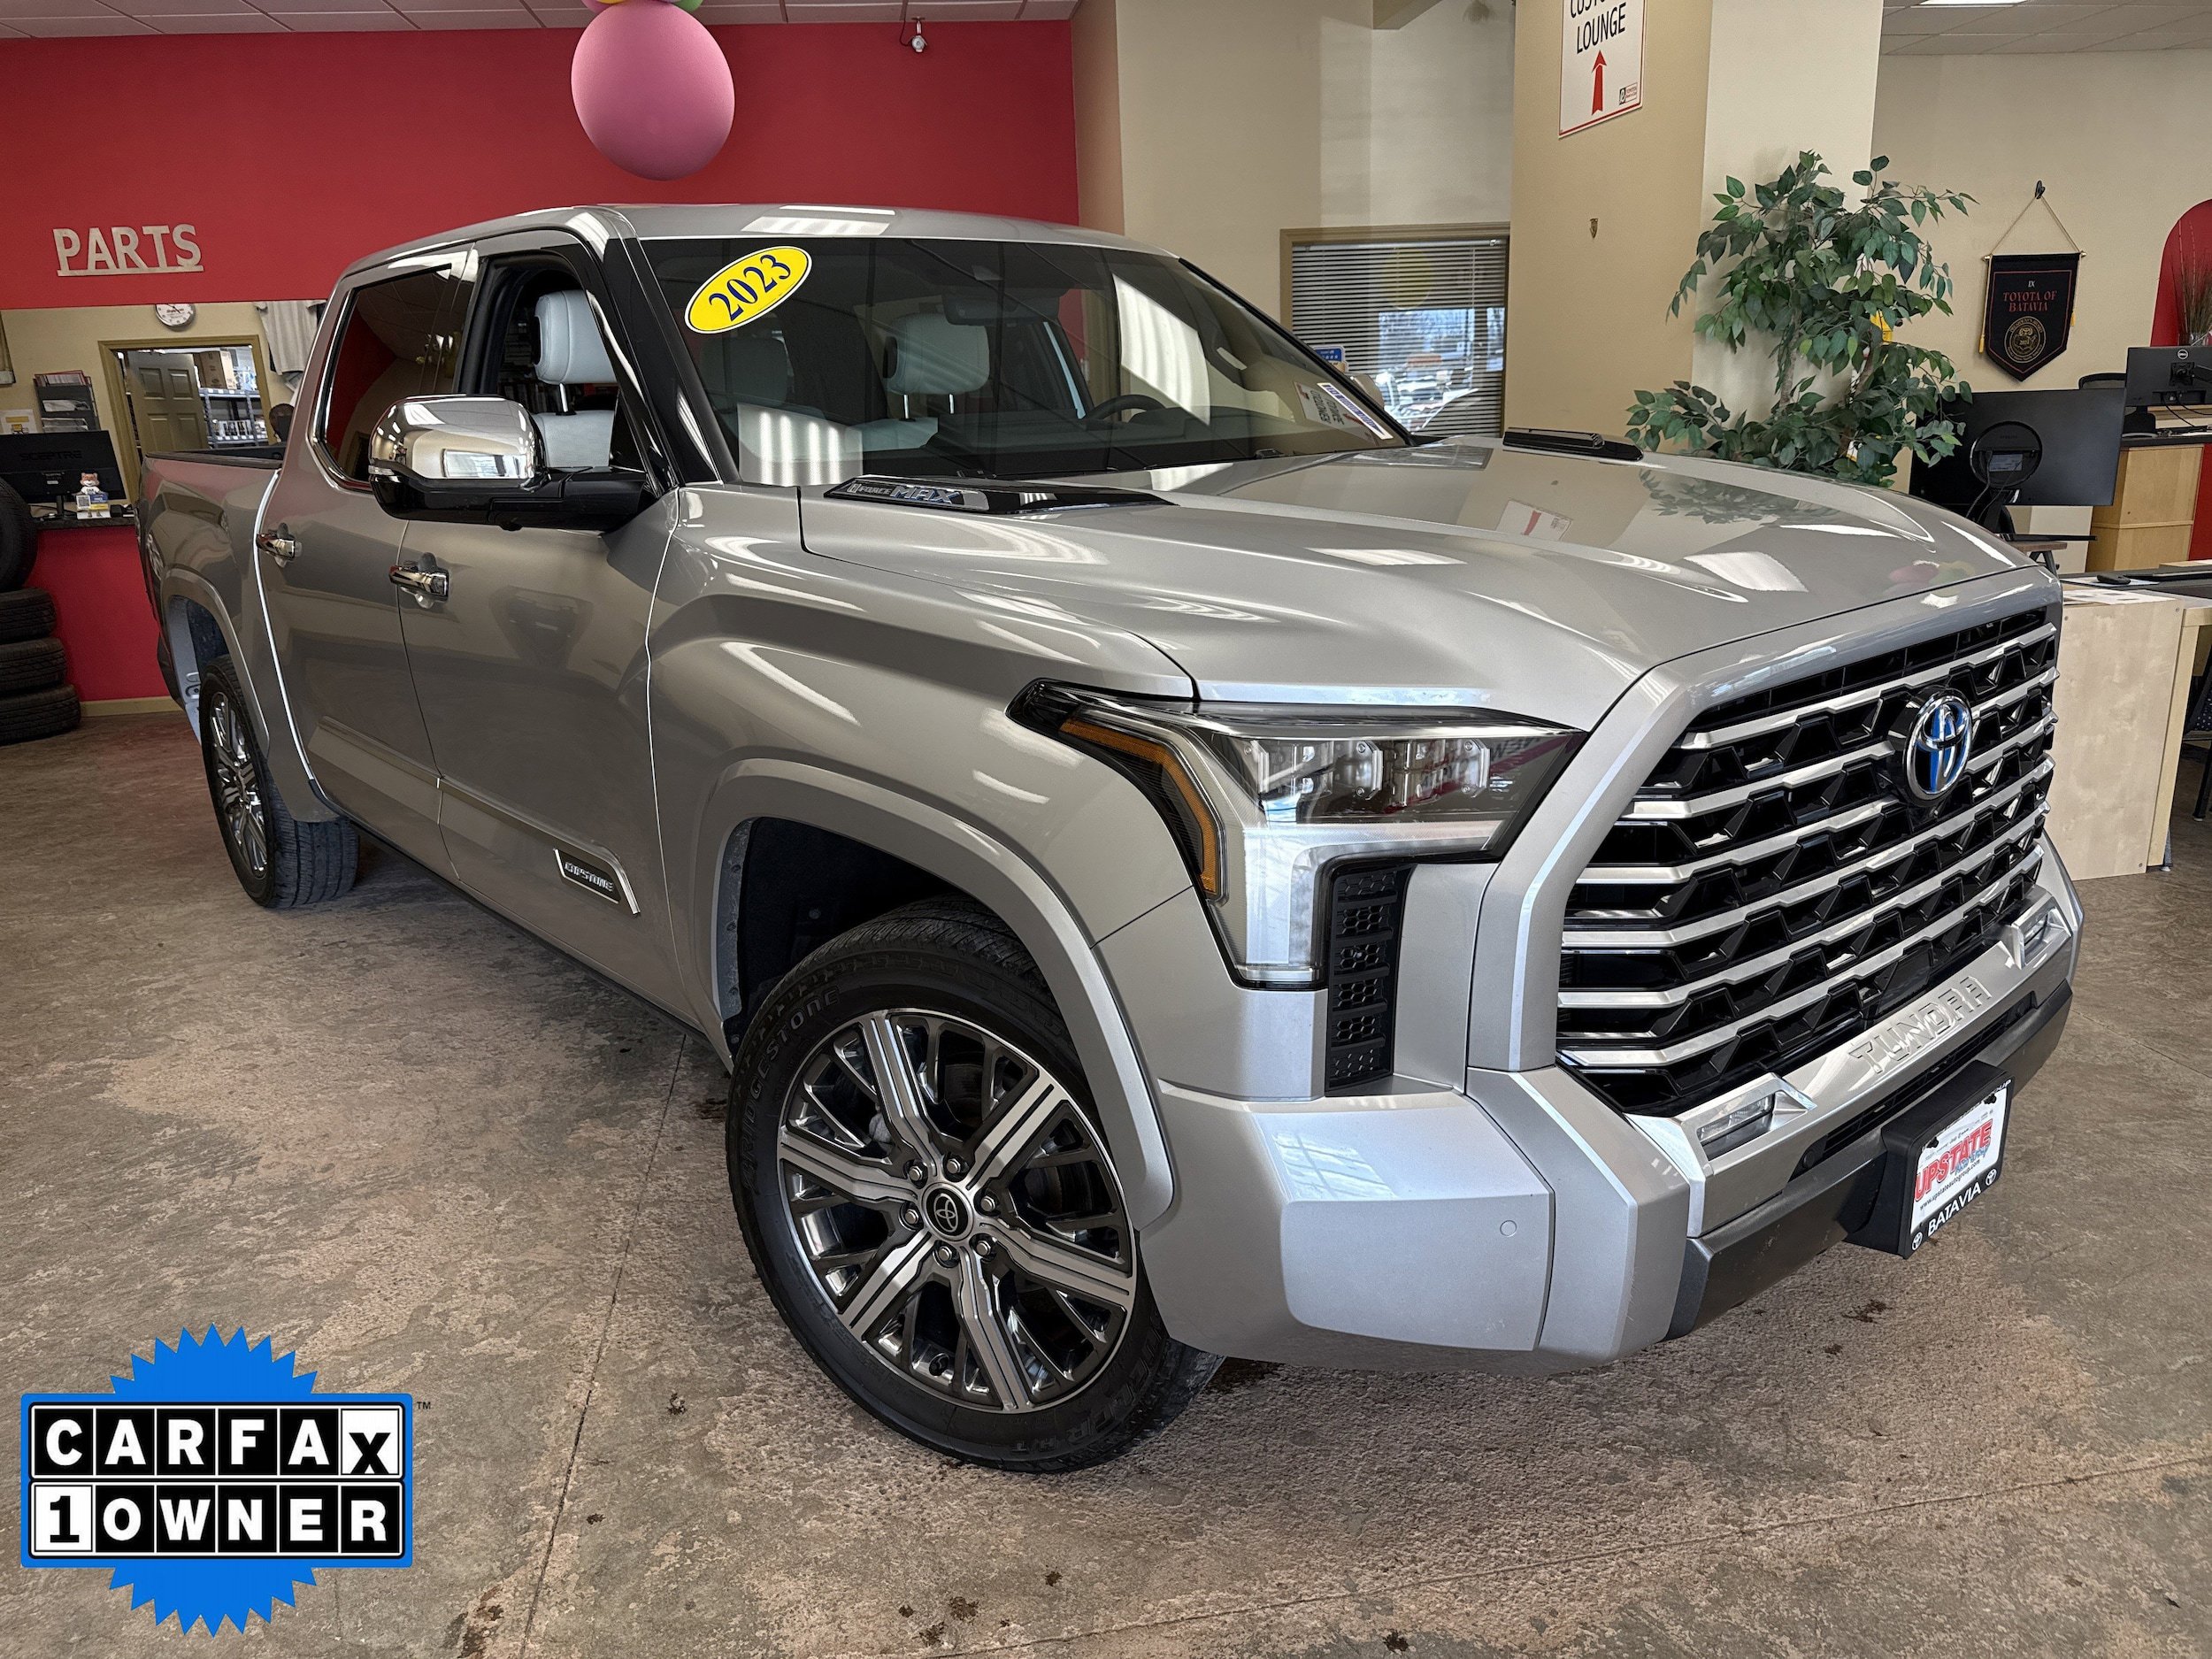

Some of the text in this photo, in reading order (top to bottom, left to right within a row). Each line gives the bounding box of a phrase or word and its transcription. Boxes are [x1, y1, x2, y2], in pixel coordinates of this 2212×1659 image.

[1577, 2, 1626, 54] LOUNGE
[53, 224, 204, 275] PARTS
[709, 254, 791, 321] 2023
[2003, 290, 2057, 302] TOYOTA OF
[2009, 302, 2047, 311] BATAVIA
[890, 485, 960, 504] MAX
[1848, 976, 1993, 1074] TUNDRA
[1915, 1118, 1993, 1202] UPSTATE
[1928, 1182, 1982, 1237] BATAVIA
